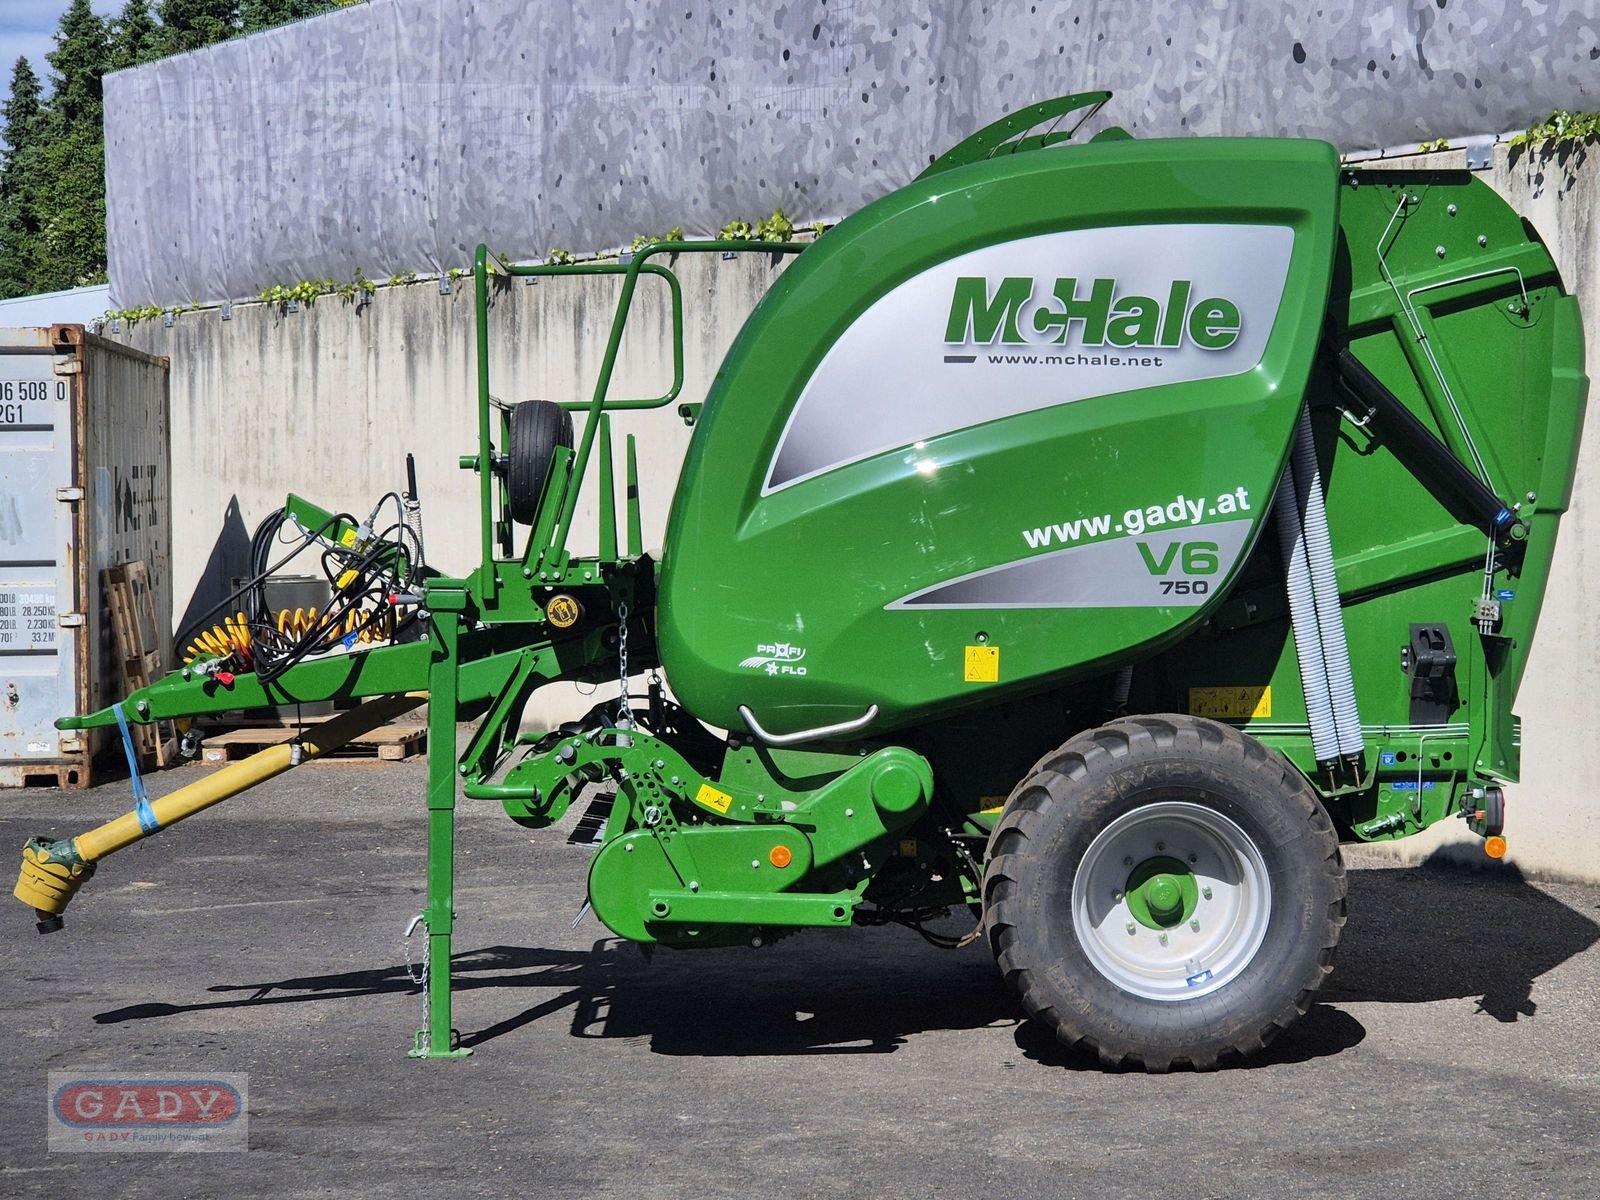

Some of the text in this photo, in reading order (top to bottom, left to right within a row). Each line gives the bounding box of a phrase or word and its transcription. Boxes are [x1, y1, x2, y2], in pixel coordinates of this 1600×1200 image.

[943, 275, 1243, 350] McHale
[987, 355, 1163, 367] www.mchale.net
[19, 381, 47, 401] 508
[1022, 486, 1251, 549] www.gady.at
[1136, 541, 1220, 576] V6
[1159, 581, 1209, 595] 750
[781, 665, 807, 676] FLO
